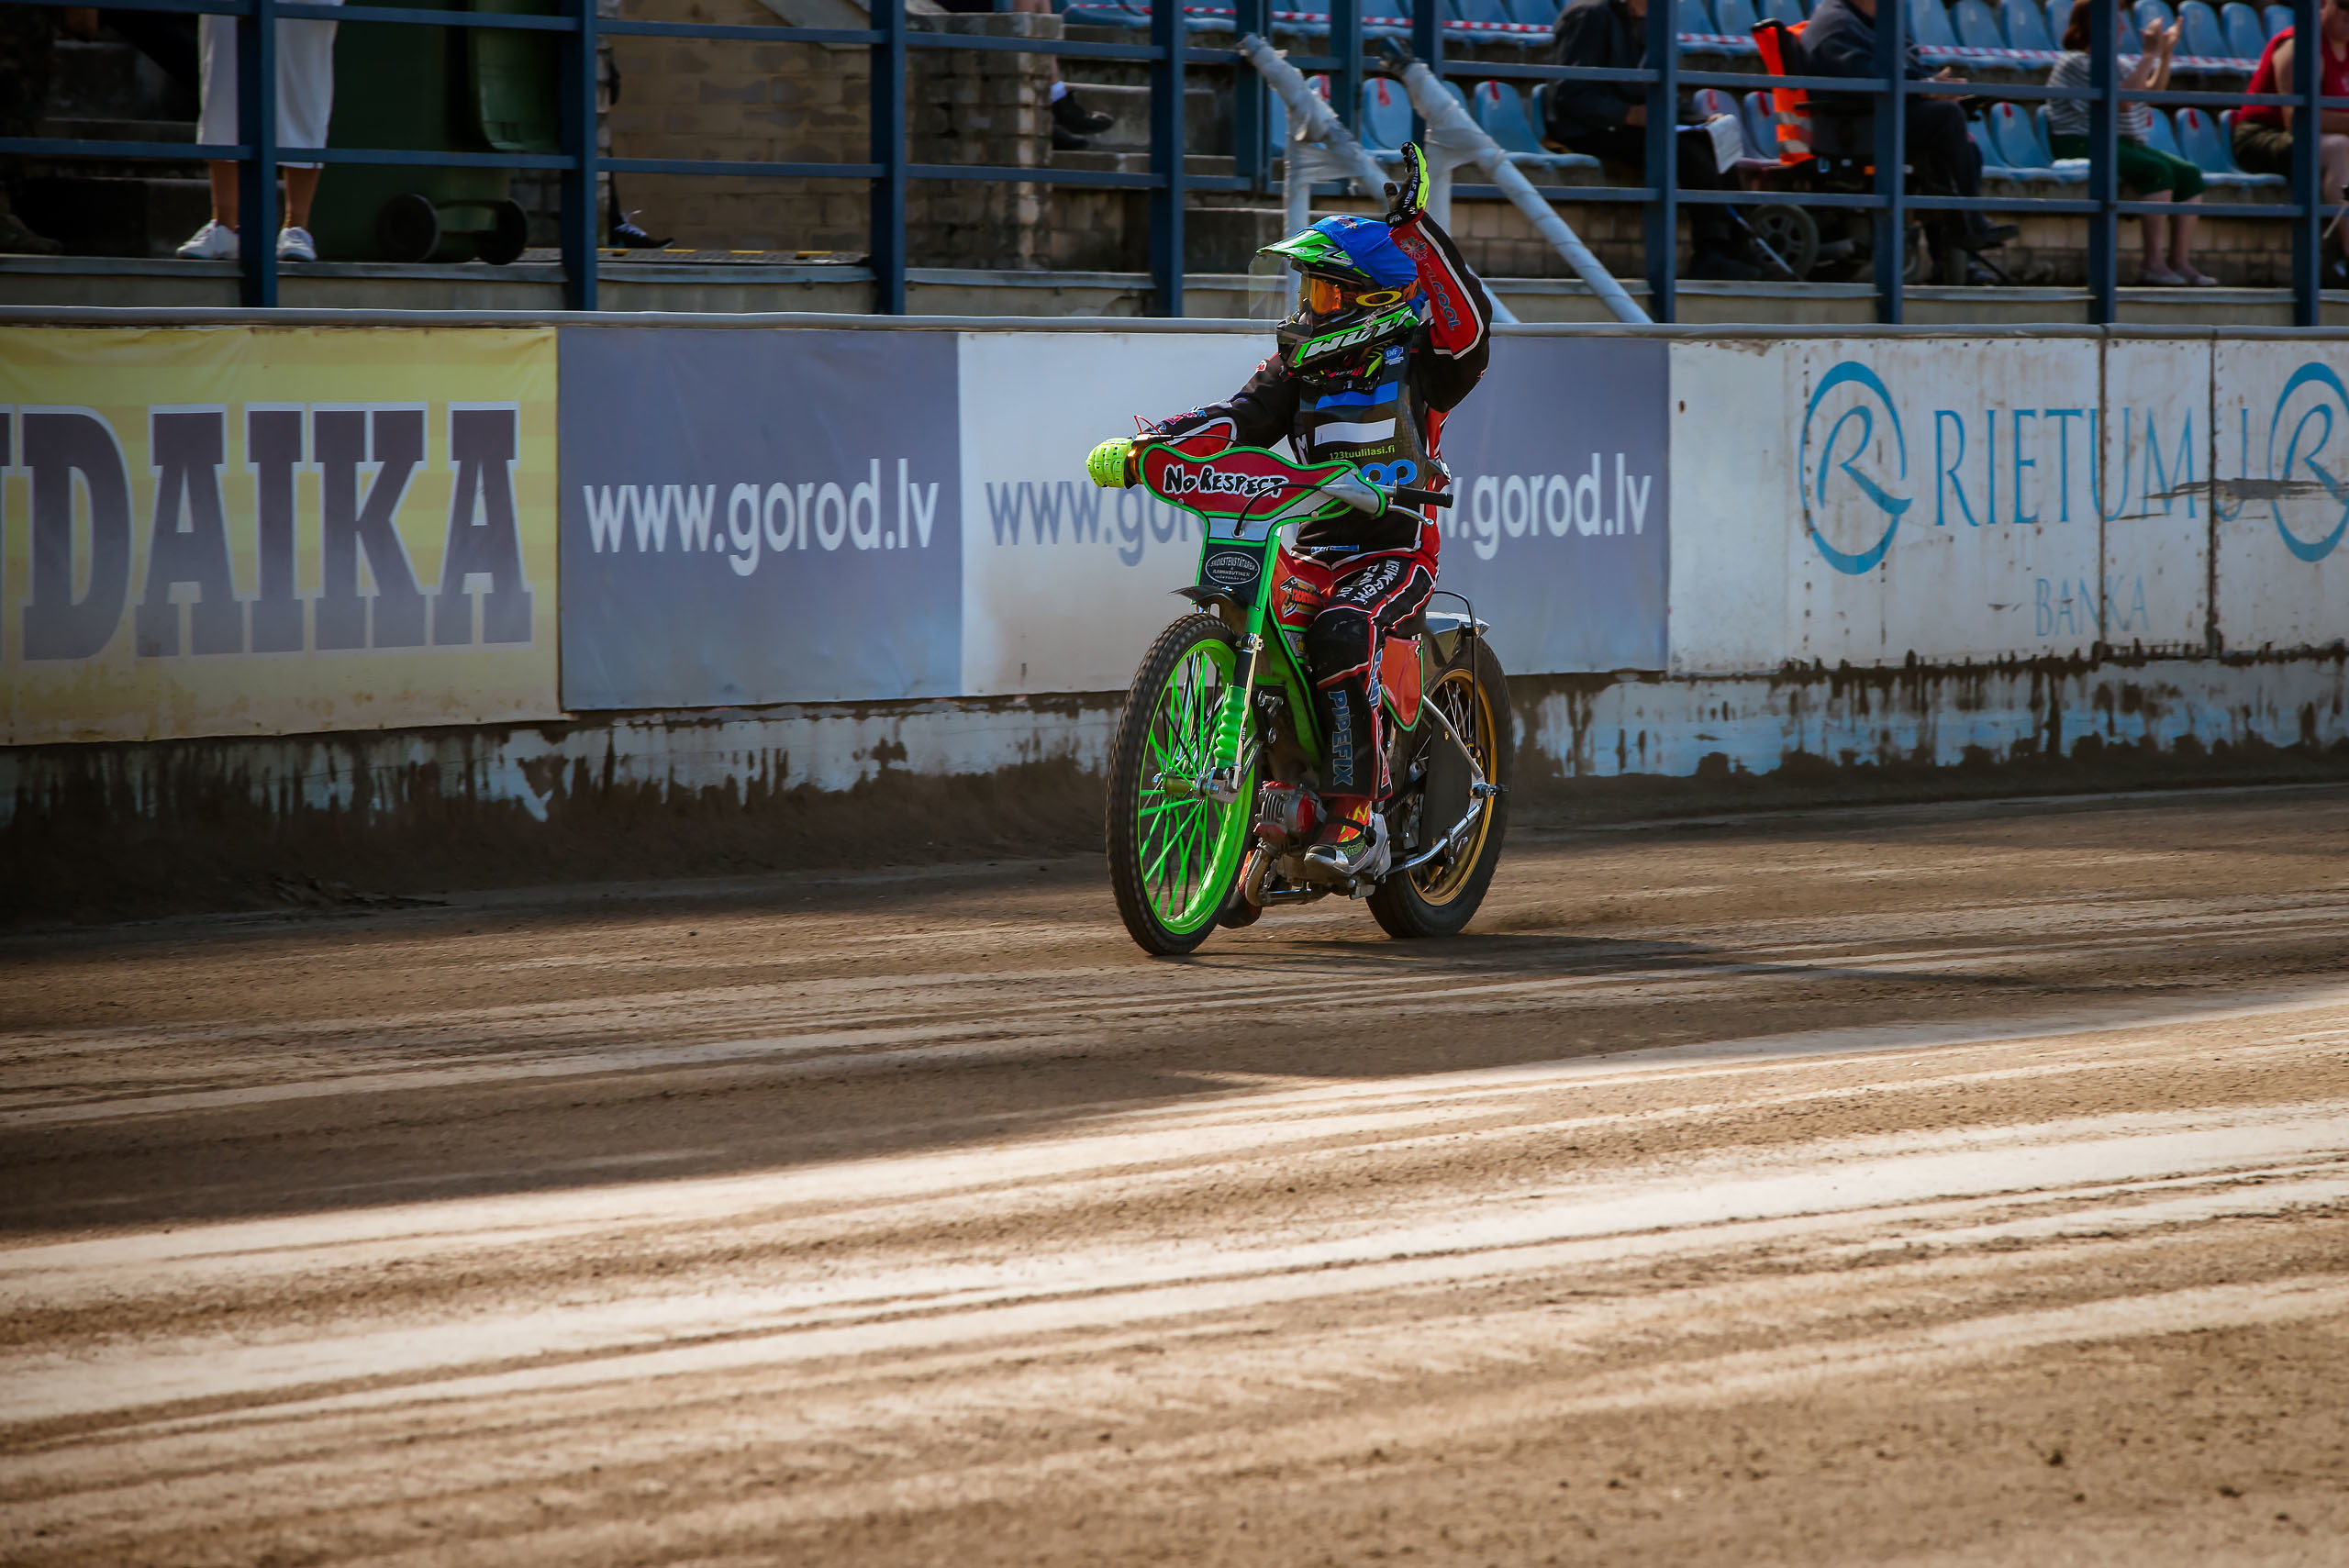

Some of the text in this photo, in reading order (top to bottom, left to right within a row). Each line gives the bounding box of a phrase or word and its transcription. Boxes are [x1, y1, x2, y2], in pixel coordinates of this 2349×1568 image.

[1198, 464, 1289, 498] RESPECT
[1330, 445, 1395, 460] 123tuulilasi.fi
[0, 402, 535, 662] DAIKA
[583, 459, 940, 576] www.gorod.lv
[2035, 575, 2150, 637] BANKA
[1328, 689, 1353, 786] PIPEFIX
